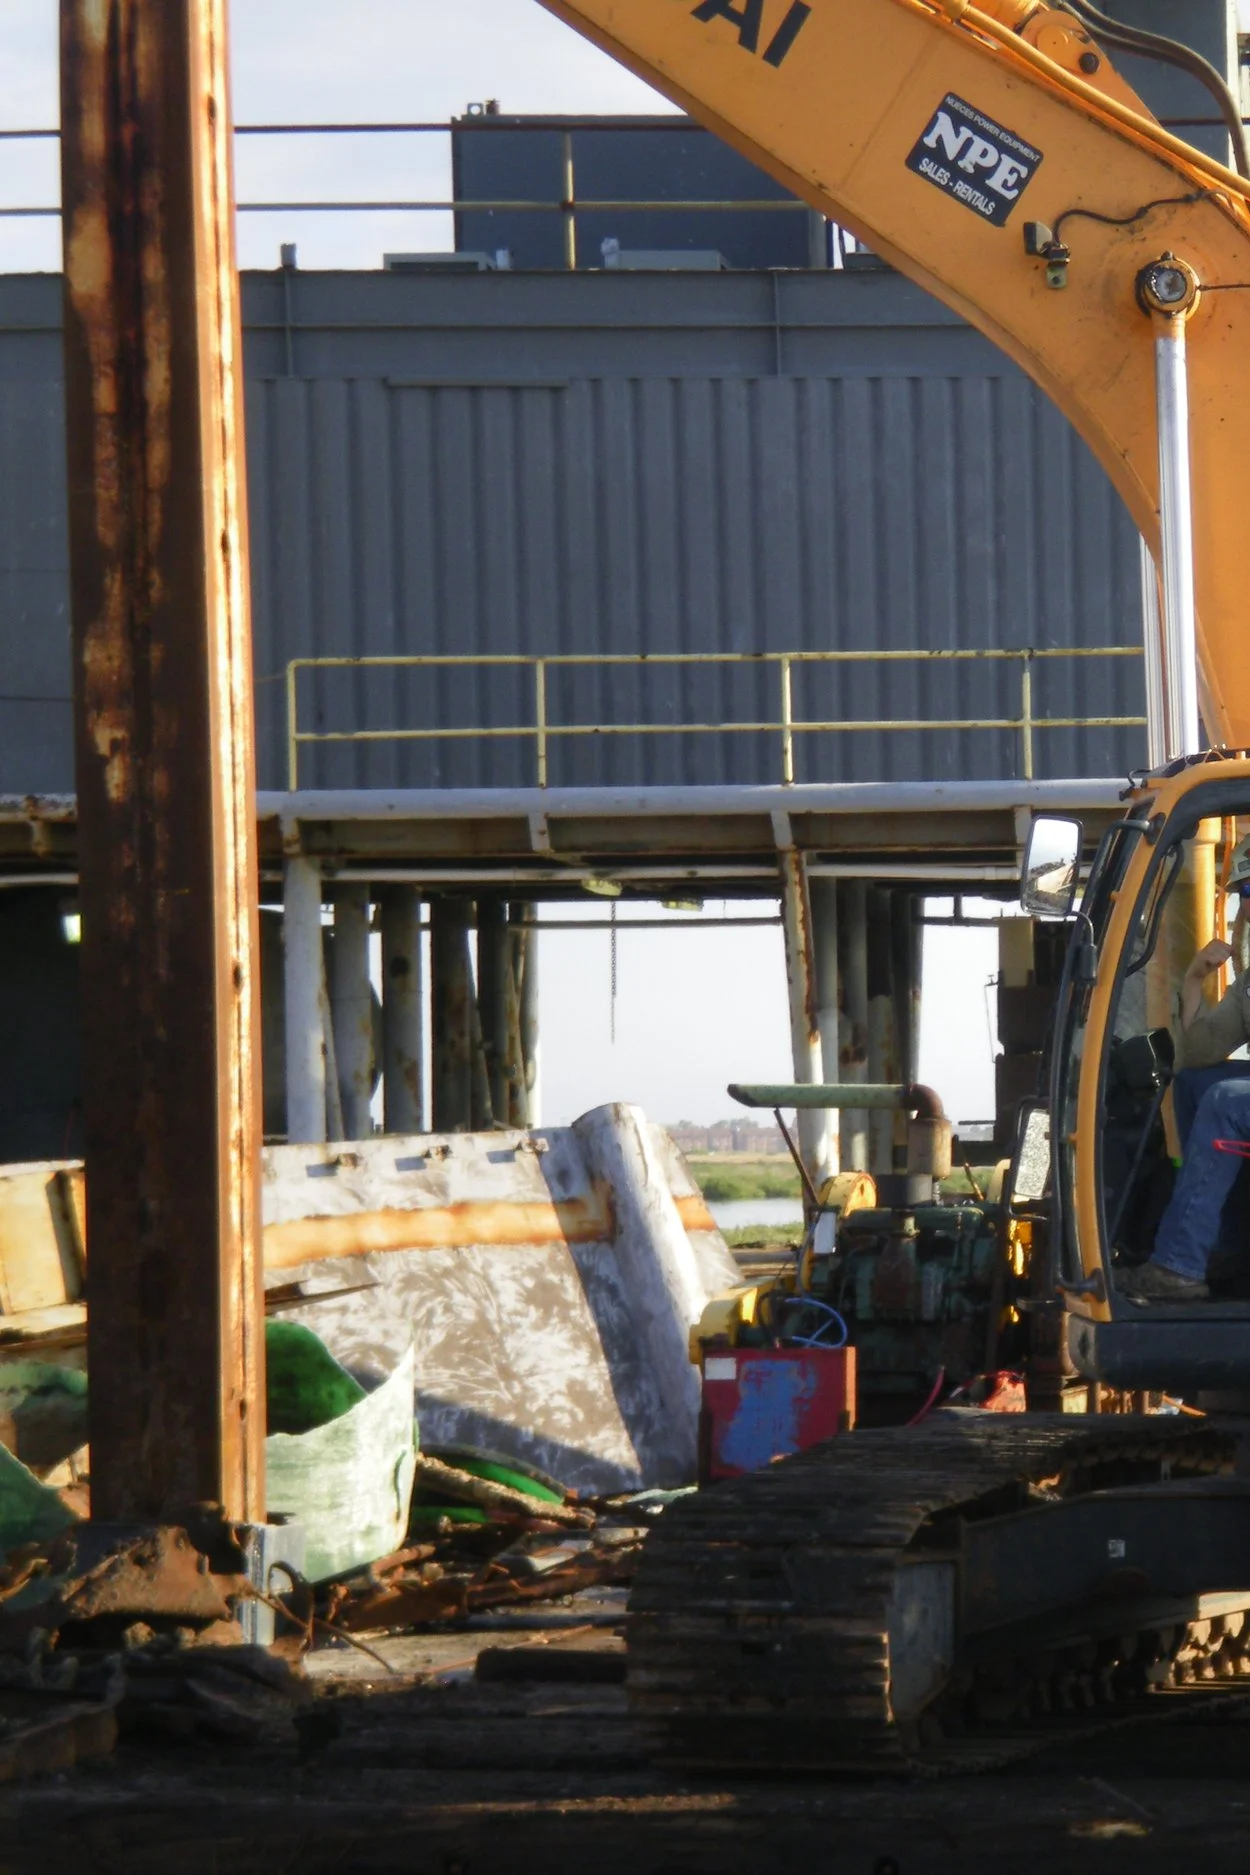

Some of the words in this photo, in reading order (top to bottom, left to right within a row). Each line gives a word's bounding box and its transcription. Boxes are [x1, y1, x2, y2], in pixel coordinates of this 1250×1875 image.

[923, 111, 1028, 200] NPE
[945, 96, 974, 119] NUECES
[973, 115, 1000, 138] POWER
[999, 134, 1040, 162] EQUIPMENT
[919, 158, 951, 185] SALES
[953, 180, 996, 215] RENTALS
